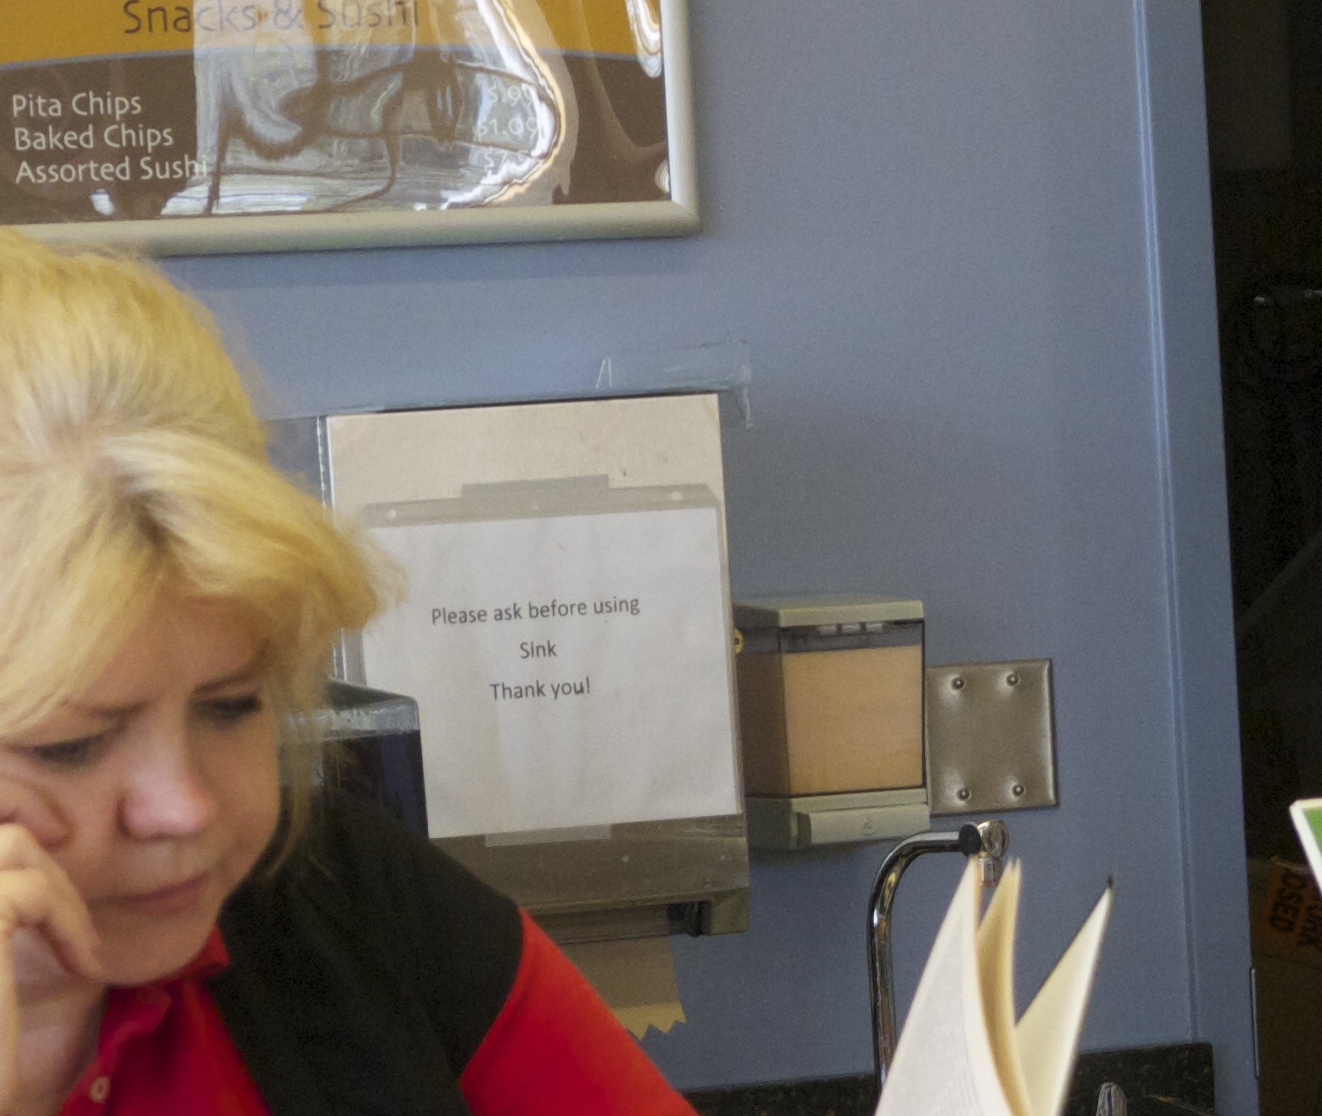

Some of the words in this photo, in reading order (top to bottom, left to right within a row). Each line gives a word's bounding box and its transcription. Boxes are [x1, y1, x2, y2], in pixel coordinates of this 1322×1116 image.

[123, 0, 258, 34] Snacks
[318, 0, 419, 29] Sushi
[12, 93, 63, 117] Pita
[71, 89, 142, 117] Chips
[14, 127, 95, 151] Baked
[104, 123, 174, 150] Chips
[15, 157, 132, 184] Assorted
[139, 154, 208, 181] Sushi
[431, 607, 487, 625] Please
[494, 602, 522, 621] ask
[528, 598, 588, 619] before
[593, 595, 640, 616] using
[519, 640, 558, 659] Sink
[490, 679, 546, 700] Thank
[550, 676, 591, 699] you!
